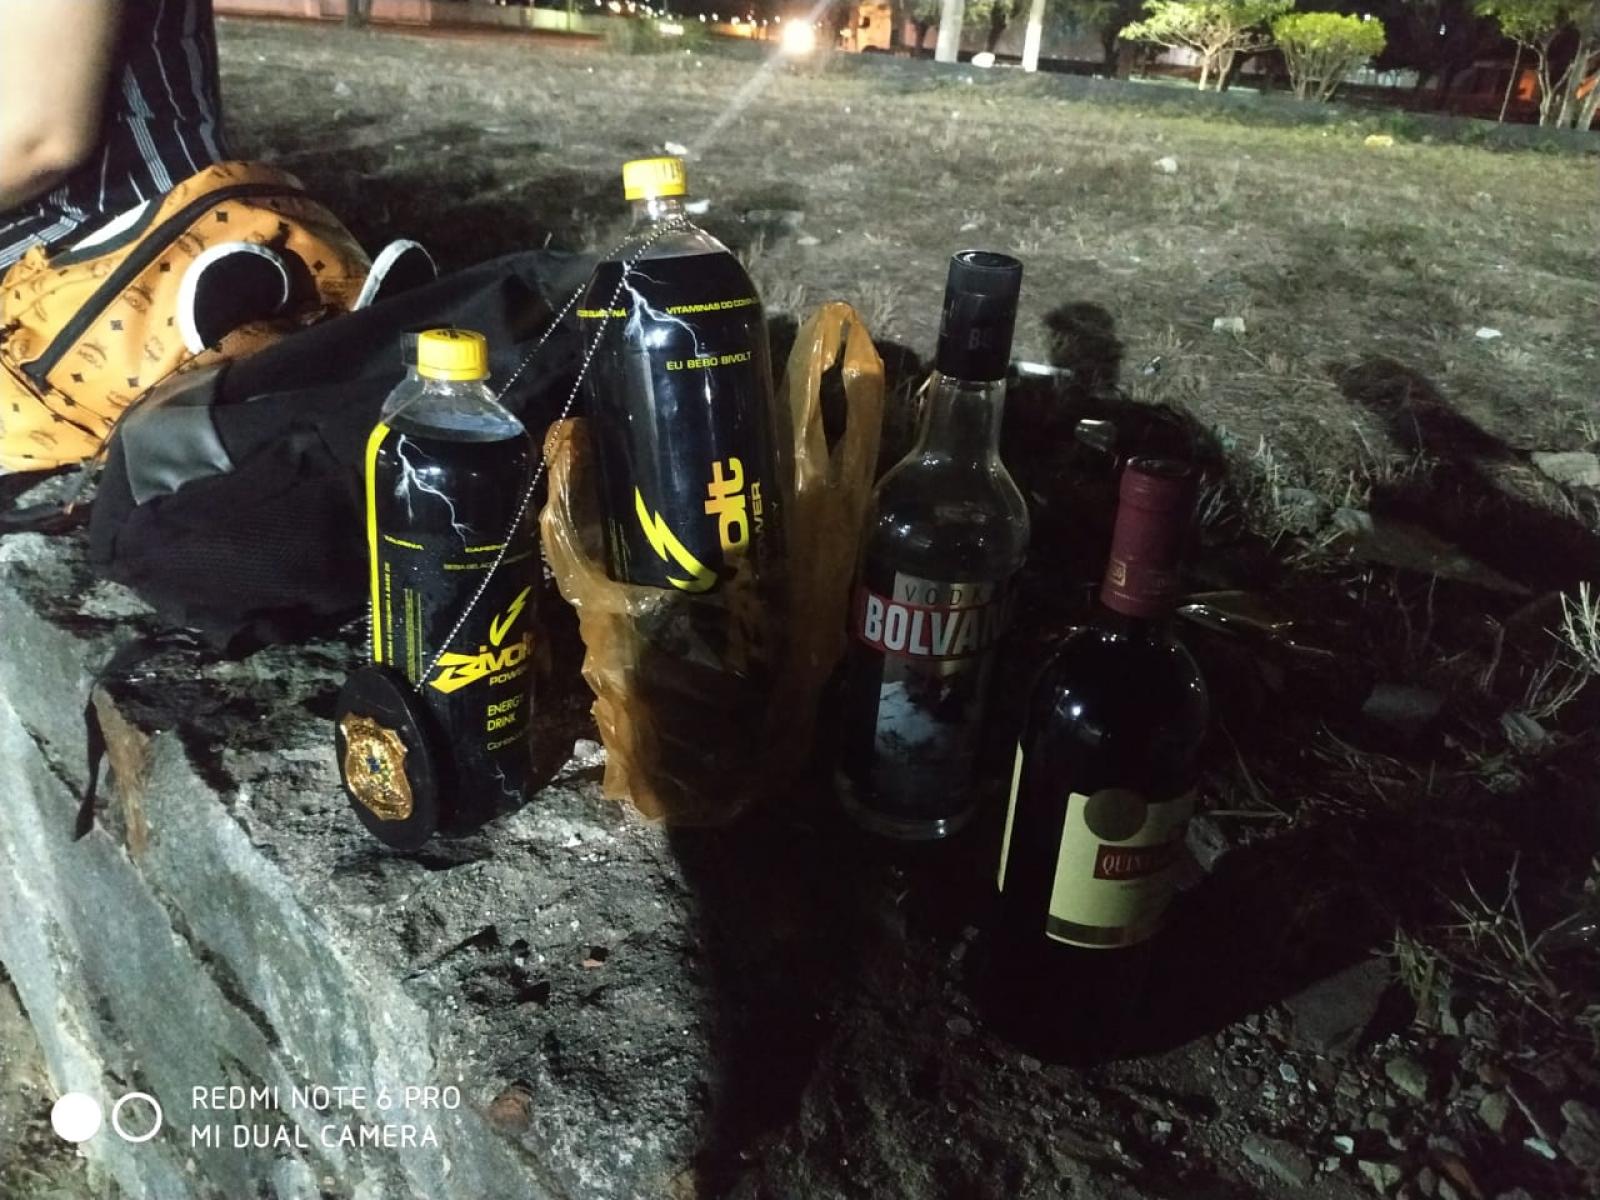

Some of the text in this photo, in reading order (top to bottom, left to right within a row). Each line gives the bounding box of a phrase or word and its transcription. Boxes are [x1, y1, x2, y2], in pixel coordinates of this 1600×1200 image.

[666, 302, 720, 315] VITAMINAS
[666, 350, 752, 371] EU BEBO BIVOLT
